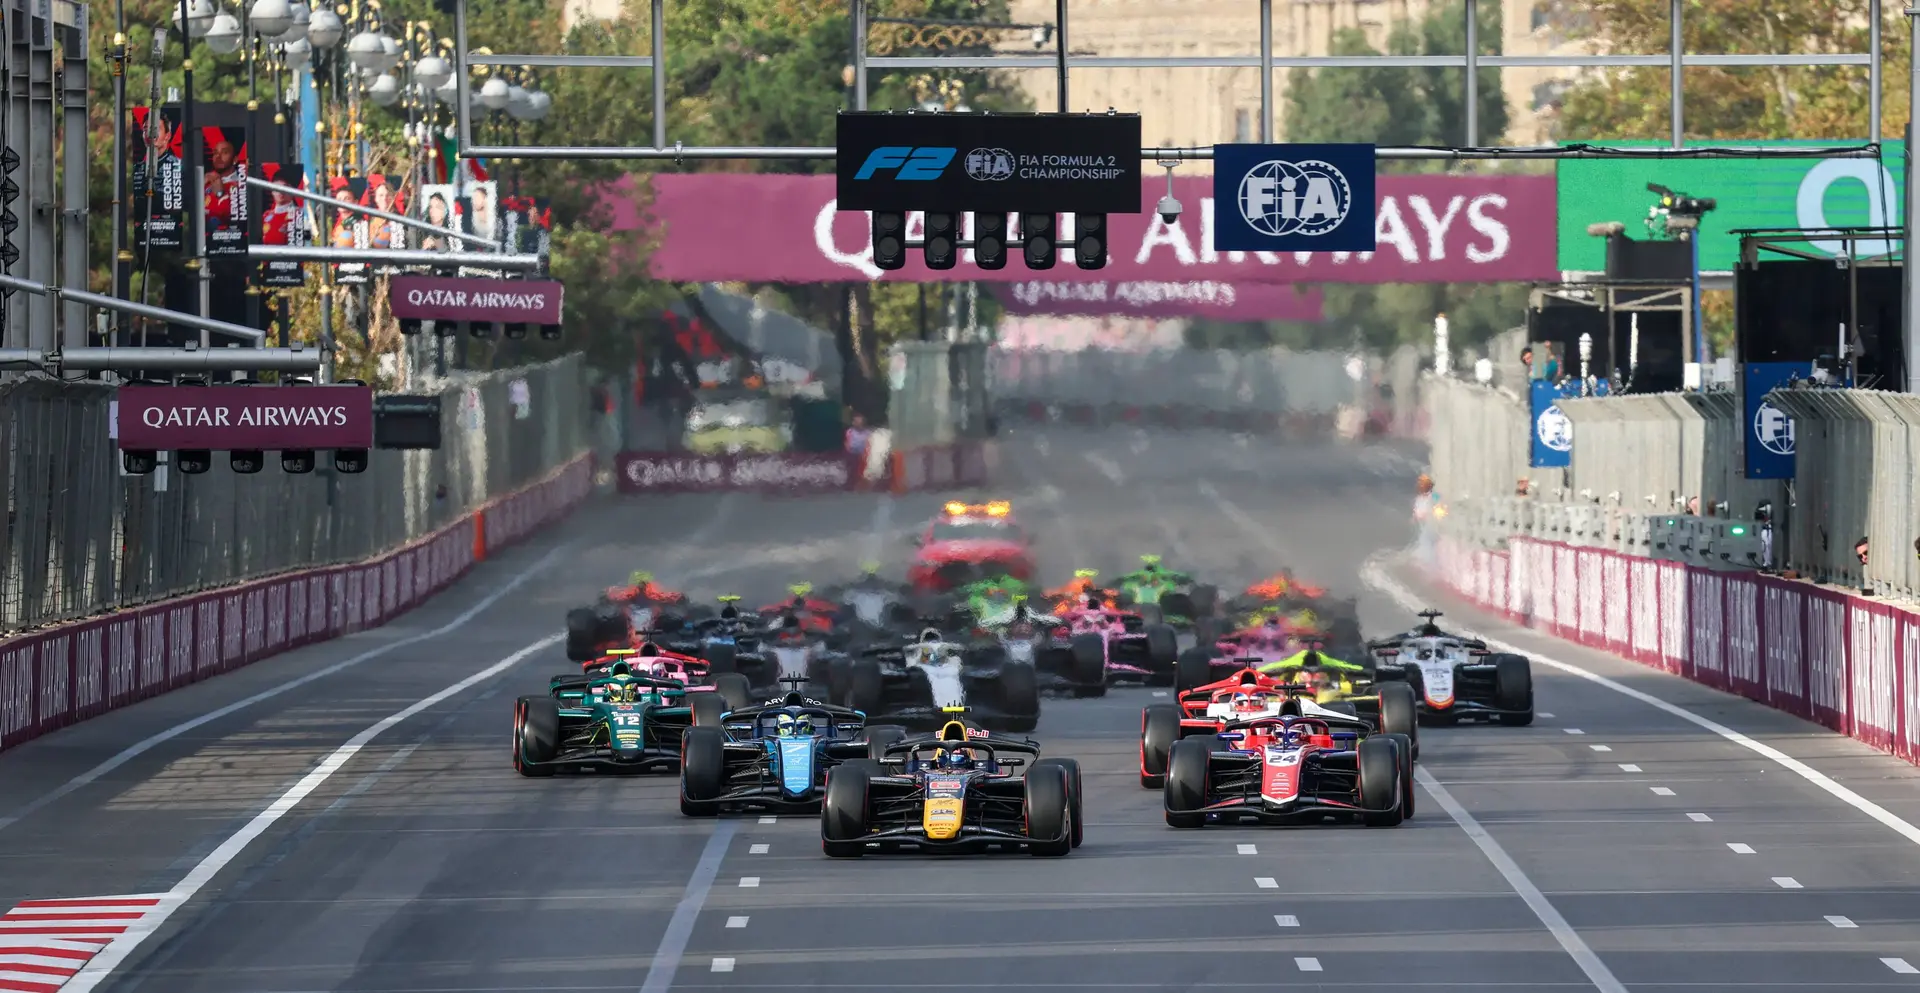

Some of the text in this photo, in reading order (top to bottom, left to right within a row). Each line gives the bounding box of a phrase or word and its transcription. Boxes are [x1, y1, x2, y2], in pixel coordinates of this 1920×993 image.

[853, 147, 957, 180] F2
[1020, 155, 1115, 166] FIA FORMULA 2
[163, 162, 173, 210] GEORGE
[173, 159, 182, 209] RUSSELL
[238, 164, 247, 220] HAMILTON
[230, 186, 238, 220] LEWIS
[408, 289, 545, 310] QATAR AIRWAYS
[143, 406, 347, 428] QATAR AIRWAYS
[613, 716, 640, 726] 12
[967, 728, 989, 738] Bull
[1269, 755, 1297, 763] 24
